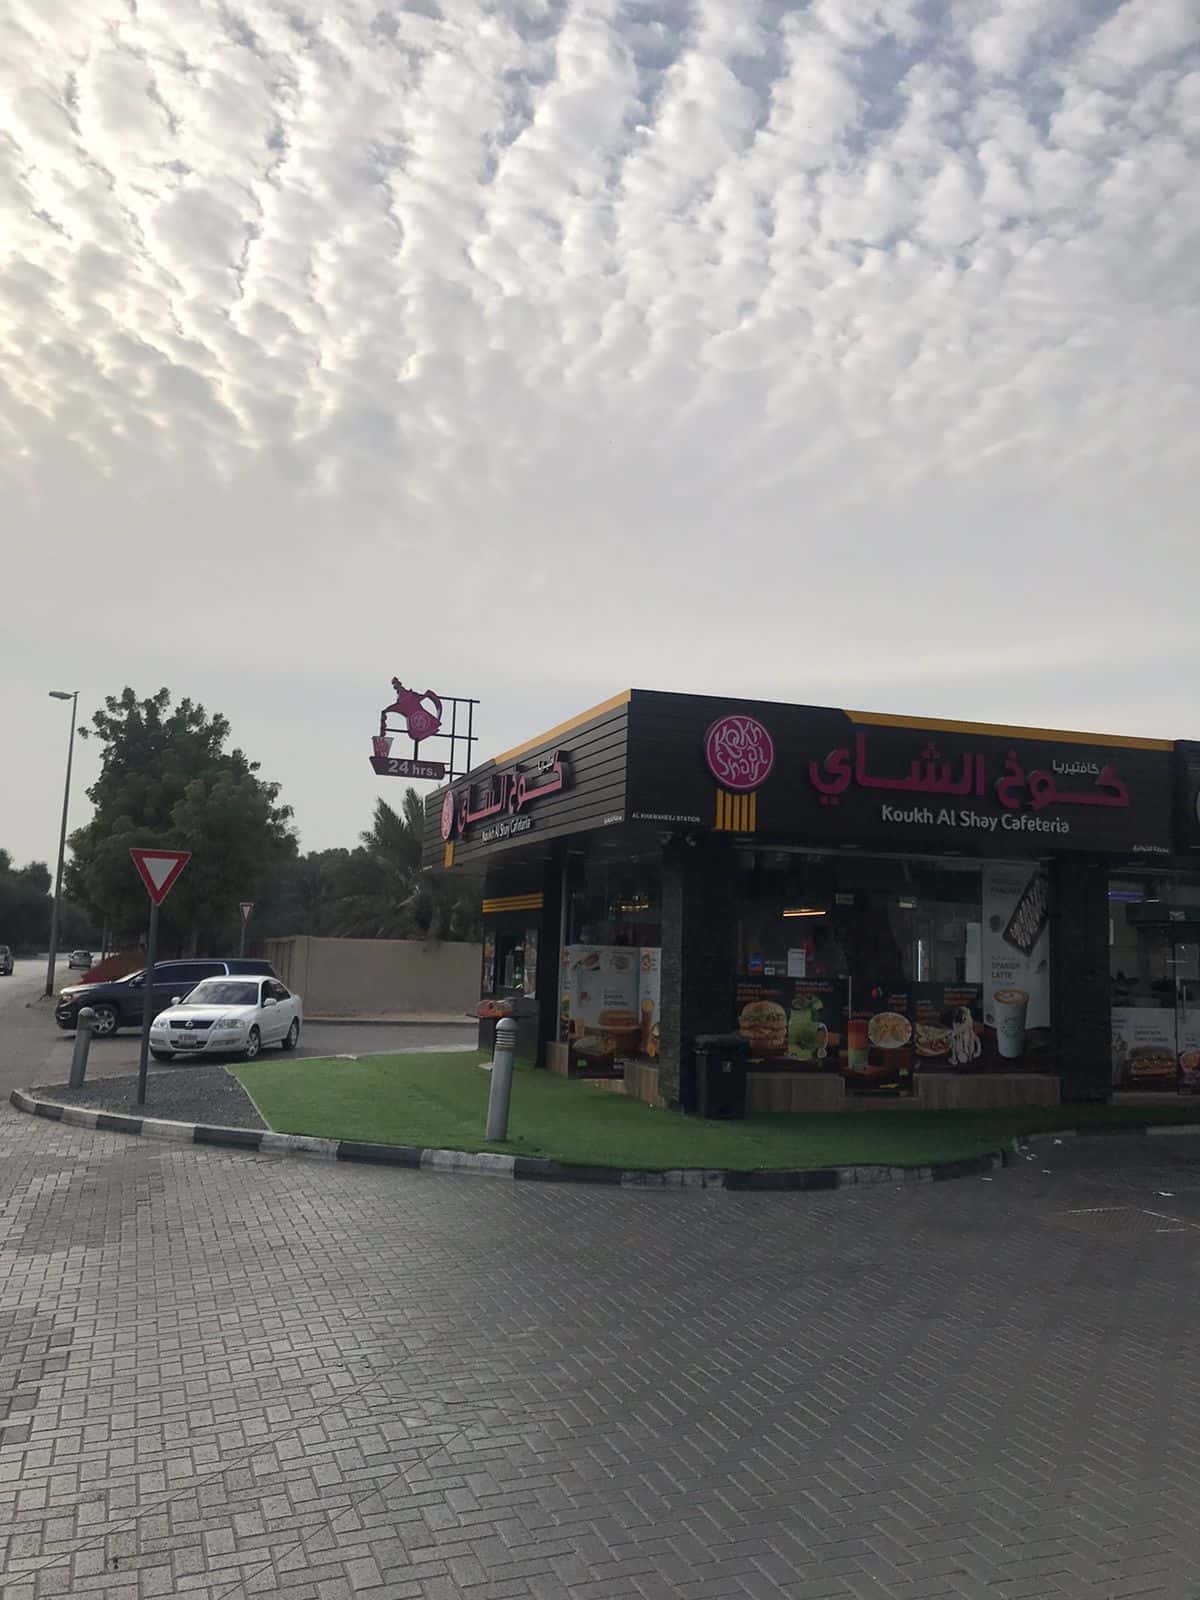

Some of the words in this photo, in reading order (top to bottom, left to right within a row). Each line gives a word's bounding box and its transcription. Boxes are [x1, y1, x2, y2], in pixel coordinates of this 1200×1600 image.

[388, 760, 409, 774] 24
[412, 764, 437, 777] hrs.
[808, 731, 985, 807] الشاي
[994, 746, 1129, 810] كوخ
[881, 805, 934, 825] Koukh
[937, 808, 956, 827] Al
[959, 810, 998, 832] Shay
[1001, 813, 1070, 834] Cafeteria
[991, 971, 1013, 980] LATTE
